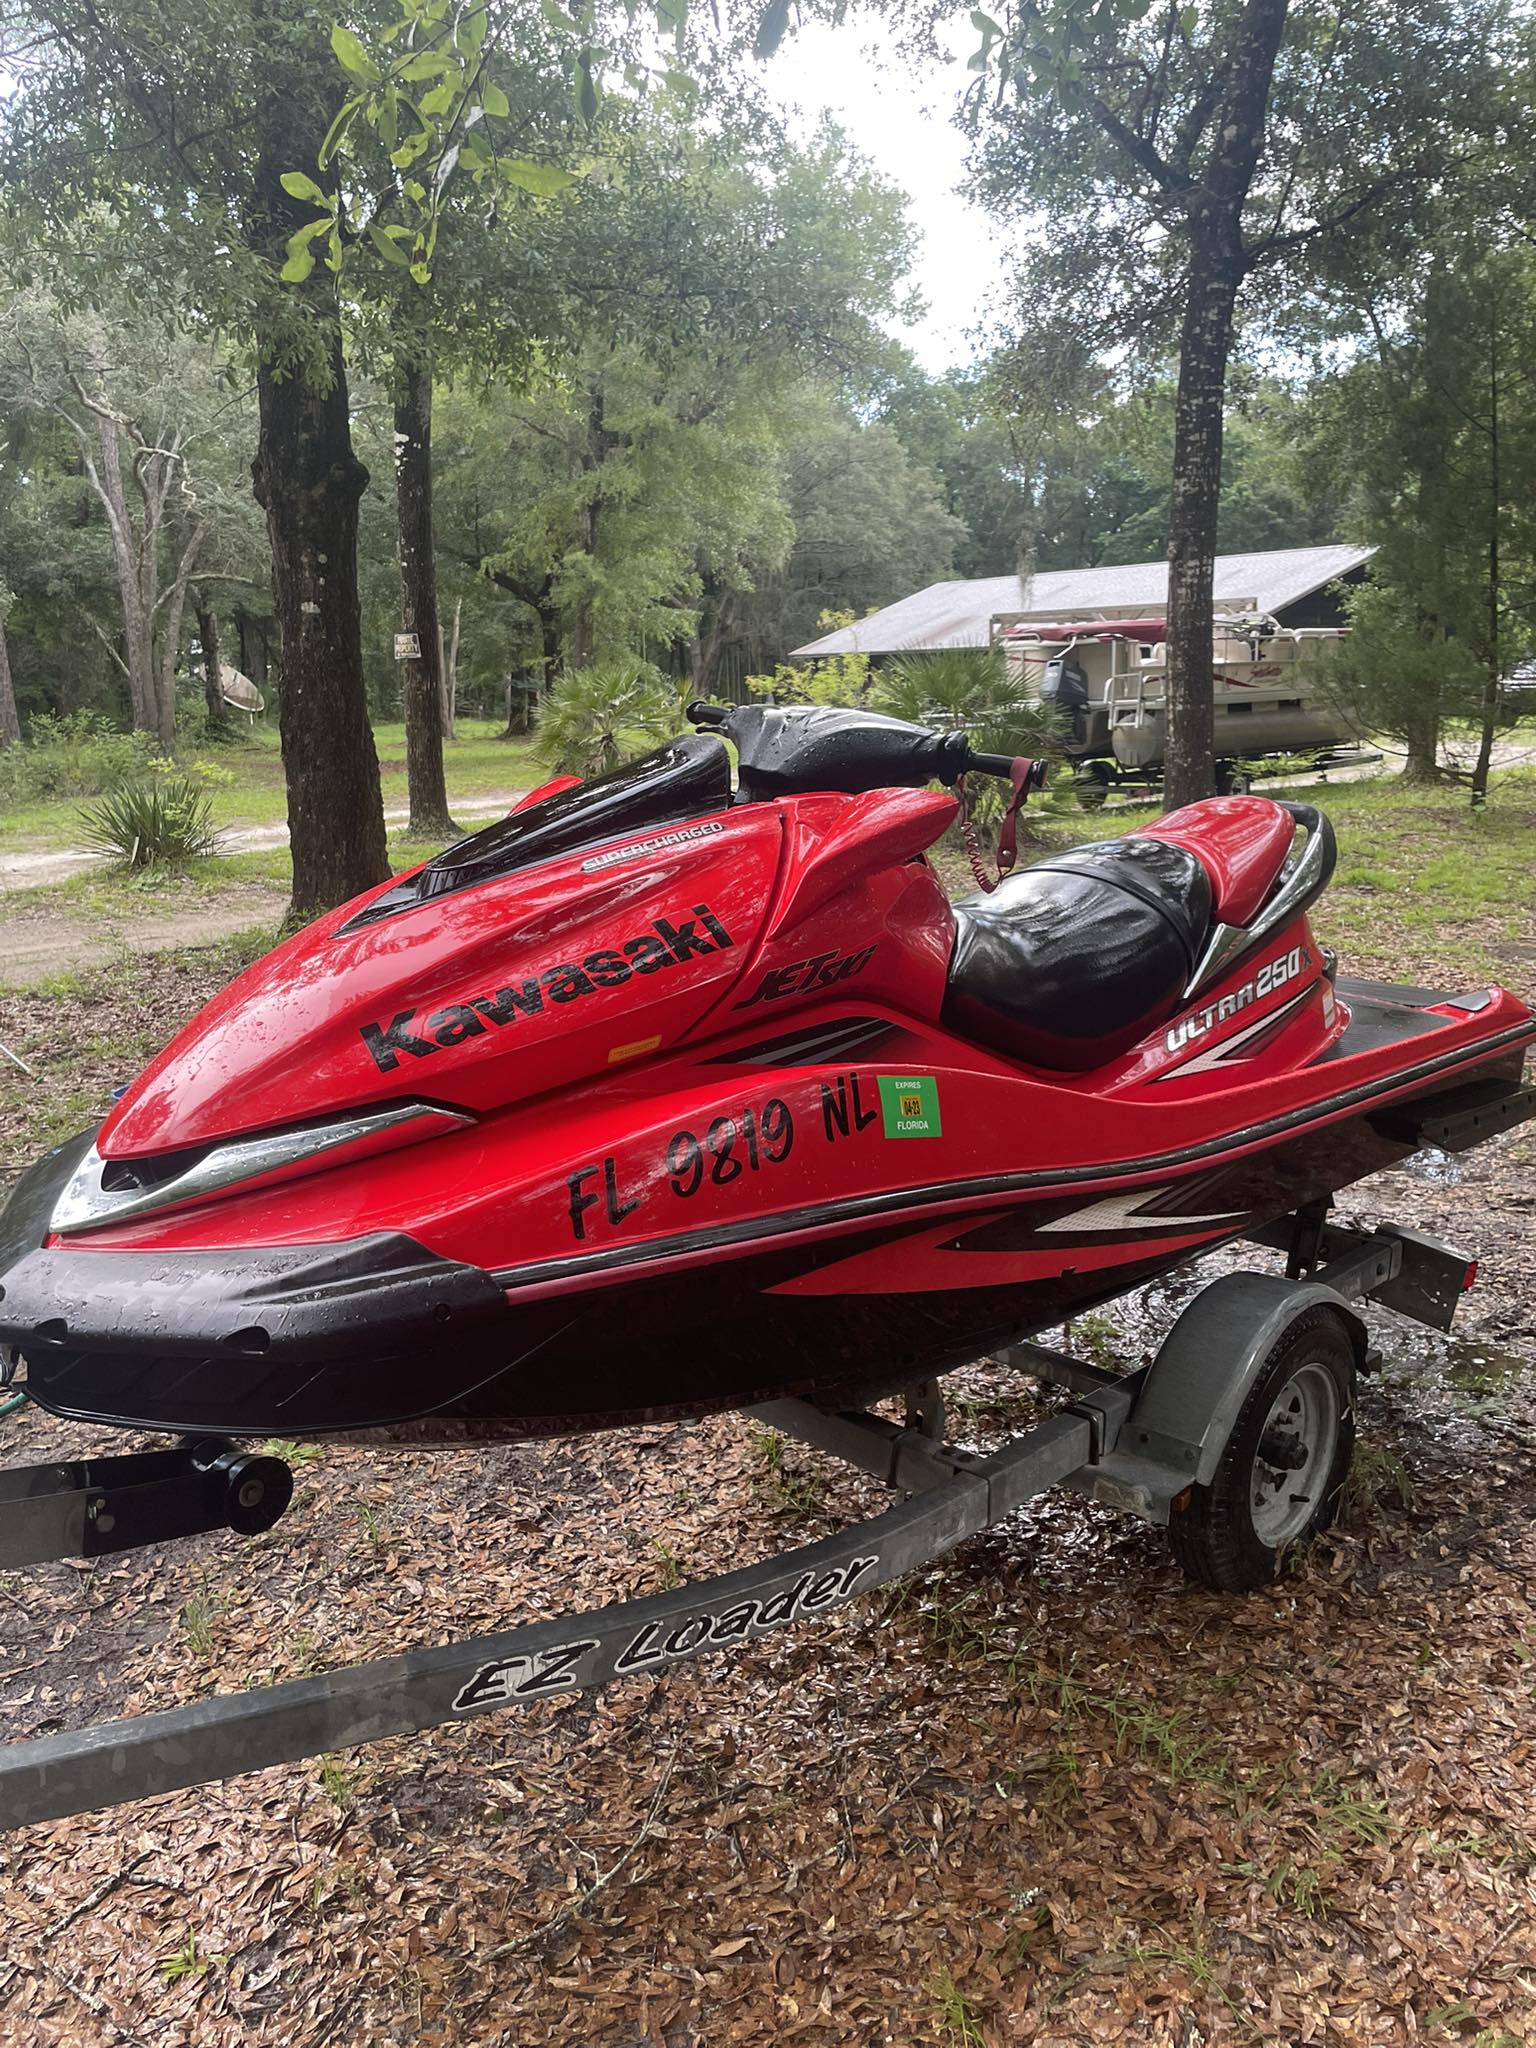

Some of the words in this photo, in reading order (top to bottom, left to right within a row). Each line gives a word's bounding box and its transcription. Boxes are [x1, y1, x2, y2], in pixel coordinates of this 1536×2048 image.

[582, 821, 724, 873] SUPERCHARGED
[359, 903, 734, 1073] Kawasaki
[1166, 983, 1254, 1052] ULTRA
[895, 1081, 922, 1090] EXPIRES
[566, 1157, 641, 1240] FL
[665, 1098, 794, 1198] 9819
[820, 1071, 878, 1142] NL
[897, 1120, 929, 1131] FLORIDA
[452, 1637, 600, 1712] EZ
[613, 1554, 881, 1674] Loader
